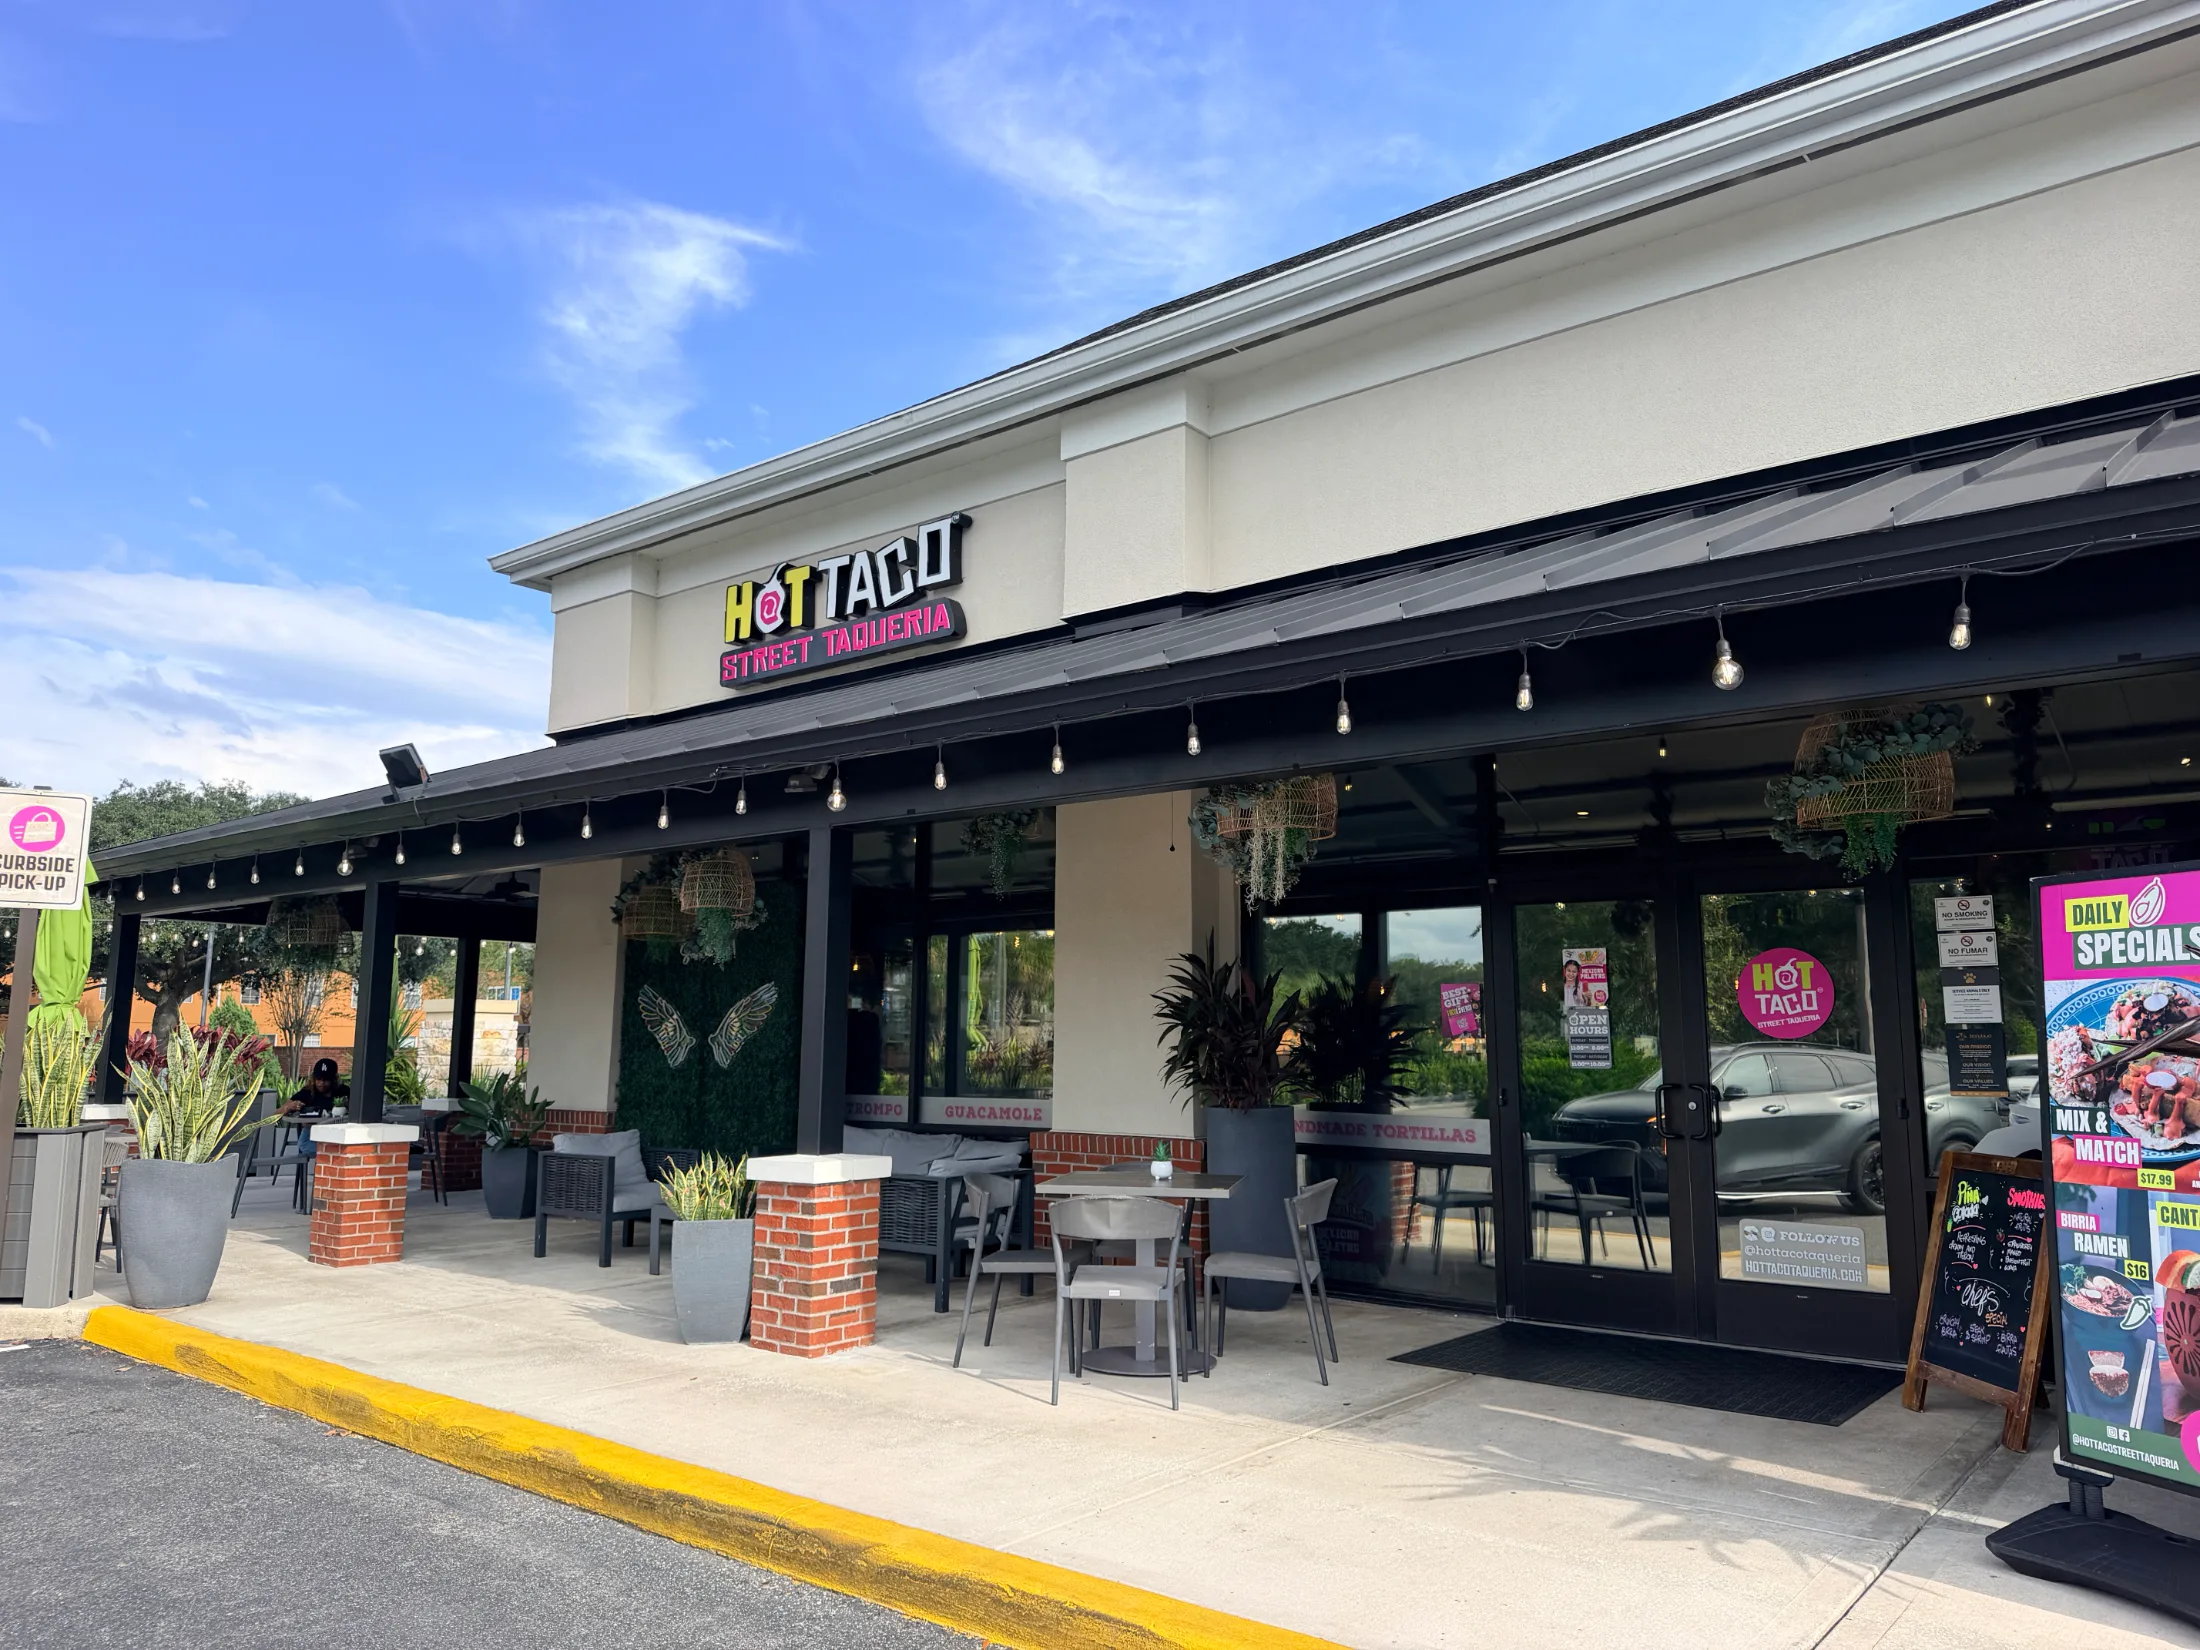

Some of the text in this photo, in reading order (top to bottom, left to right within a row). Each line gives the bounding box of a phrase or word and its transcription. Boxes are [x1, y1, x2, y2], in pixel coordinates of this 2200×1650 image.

[725, 562, 811, 643] HOT
[818, 518, 951, 619] TACO
[722, 603, 950, 681] STREET TAQUERIA
[0, 854, 75, 873] URBSIDE
[0, 874, 66, 891] PICK-UP
[1954, 910, 1988, 918] SMOKING
[2072, 901, 2123, 926] DAILY
[1752, 958, 1814, 991] HOT
[1442, 987, 1467, 1000] BEST
[1444, 995, 1469, 1008] GIFT
[1755, 991, 1818, 1015] TACO
[1569, 1012, 1607, 1026] OPEN
[1758, 1014, 1820, 1028] STREET TAQUERIA
[1570, 1026, 1608, 1035] HOURS
[945, 1105, 1043, 1121] GUACAMOLE
[2056, 1109, 2108, 1134] MIX &
[1294, 1120, 1477, 1143] NDMADE TORTILLAS
[2076, 1138, 2140, 1165] MATCH
[2140, 1173, 2172, 1185] $17.99
[2060, 1213, 2096, 1231] BIRRIA
[2160, 1206, 2200, 1227] CANT
[1841, 1236, 1860, 1246] US
[2074, 1232, 2128, 1258] RAMEN
[1745, 1245, 1861, 1264] @hottacotaqueria
[1745, 1260, 1862, 1283] HOTTACOTAQUERIA.COM
[2127, 1263, 2147, 1278] $16
[2072, 1434, 2180, 1471] @HOTTACOSTREETTAQUERIA
